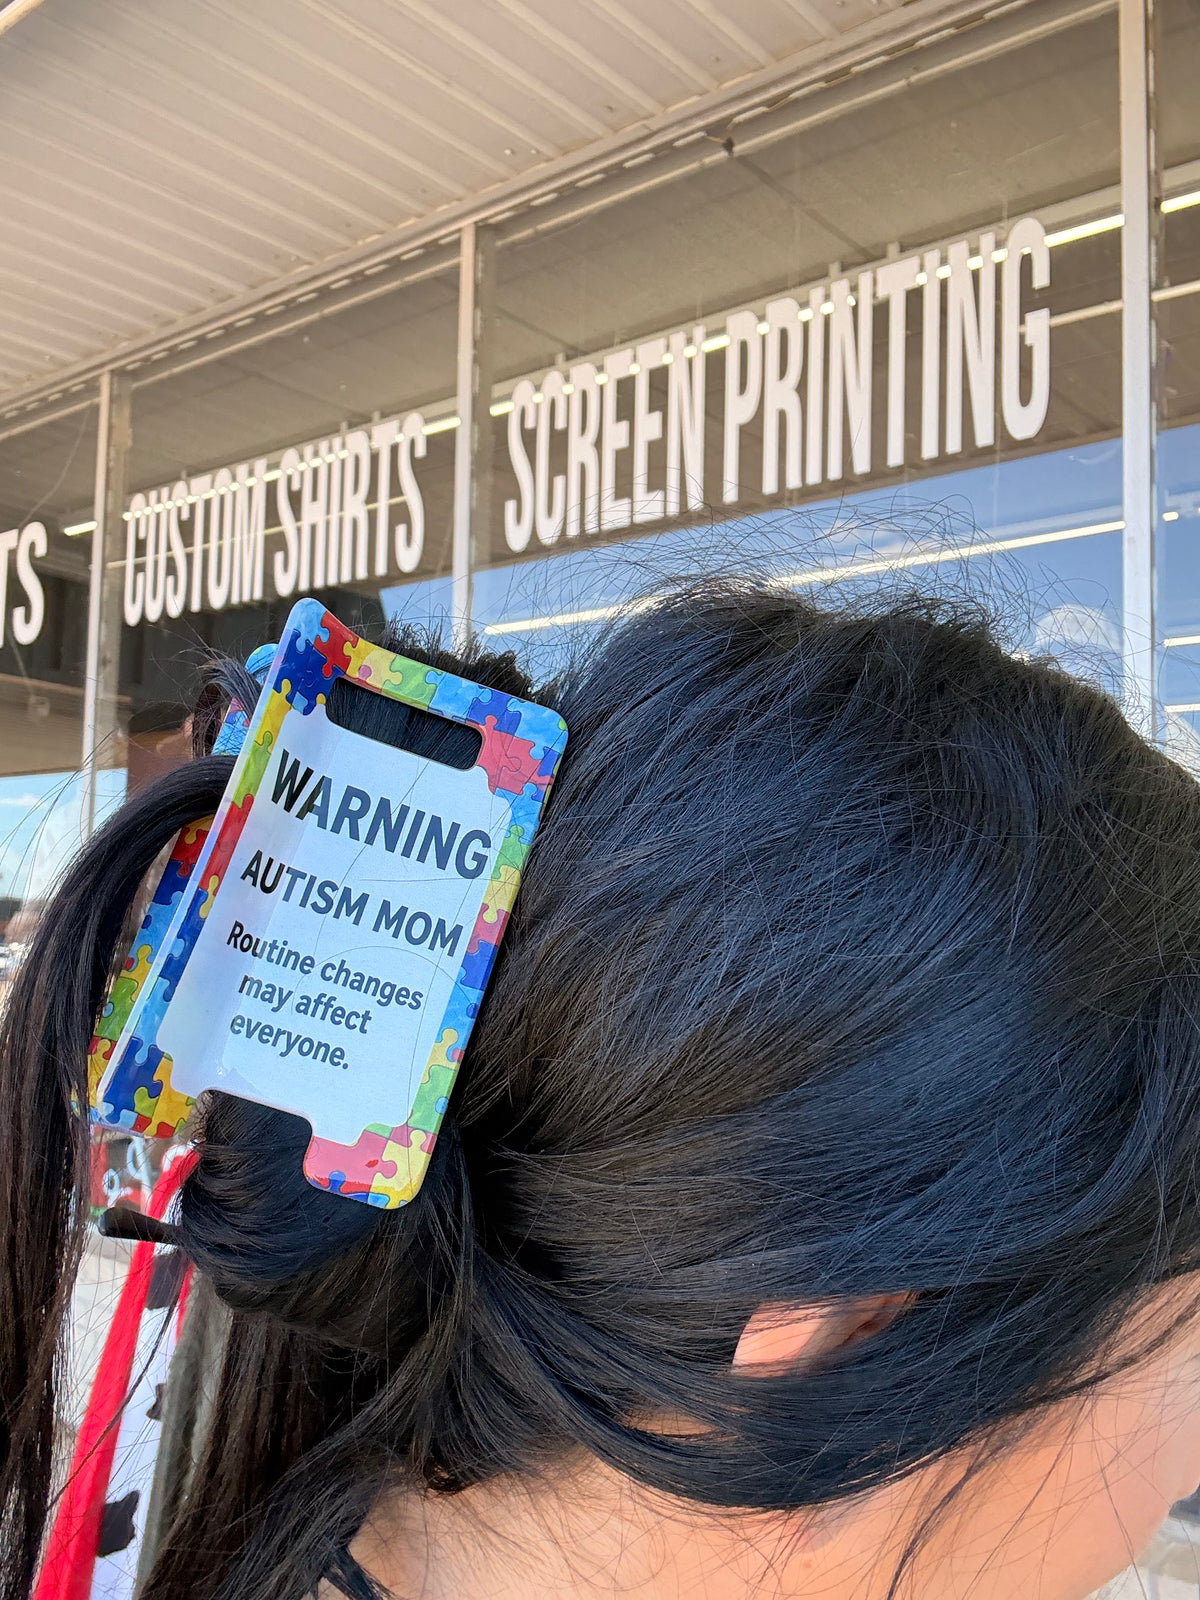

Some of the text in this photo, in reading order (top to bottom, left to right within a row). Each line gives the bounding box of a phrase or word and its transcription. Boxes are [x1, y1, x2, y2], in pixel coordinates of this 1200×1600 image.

[505, 216, 1051, 553] SCREEN PRINTING
[123, 412, 427, 627] CUSTOM SHIRTS
[271, 748, 492, 880] WARNING
[240, 849, 464, 958] AUTISM MOM
[226, 920, 424, 1011] Routine changes
[237, 974, 372, 1035] may affect
[230, 1013, 349, 1070] everyone.
